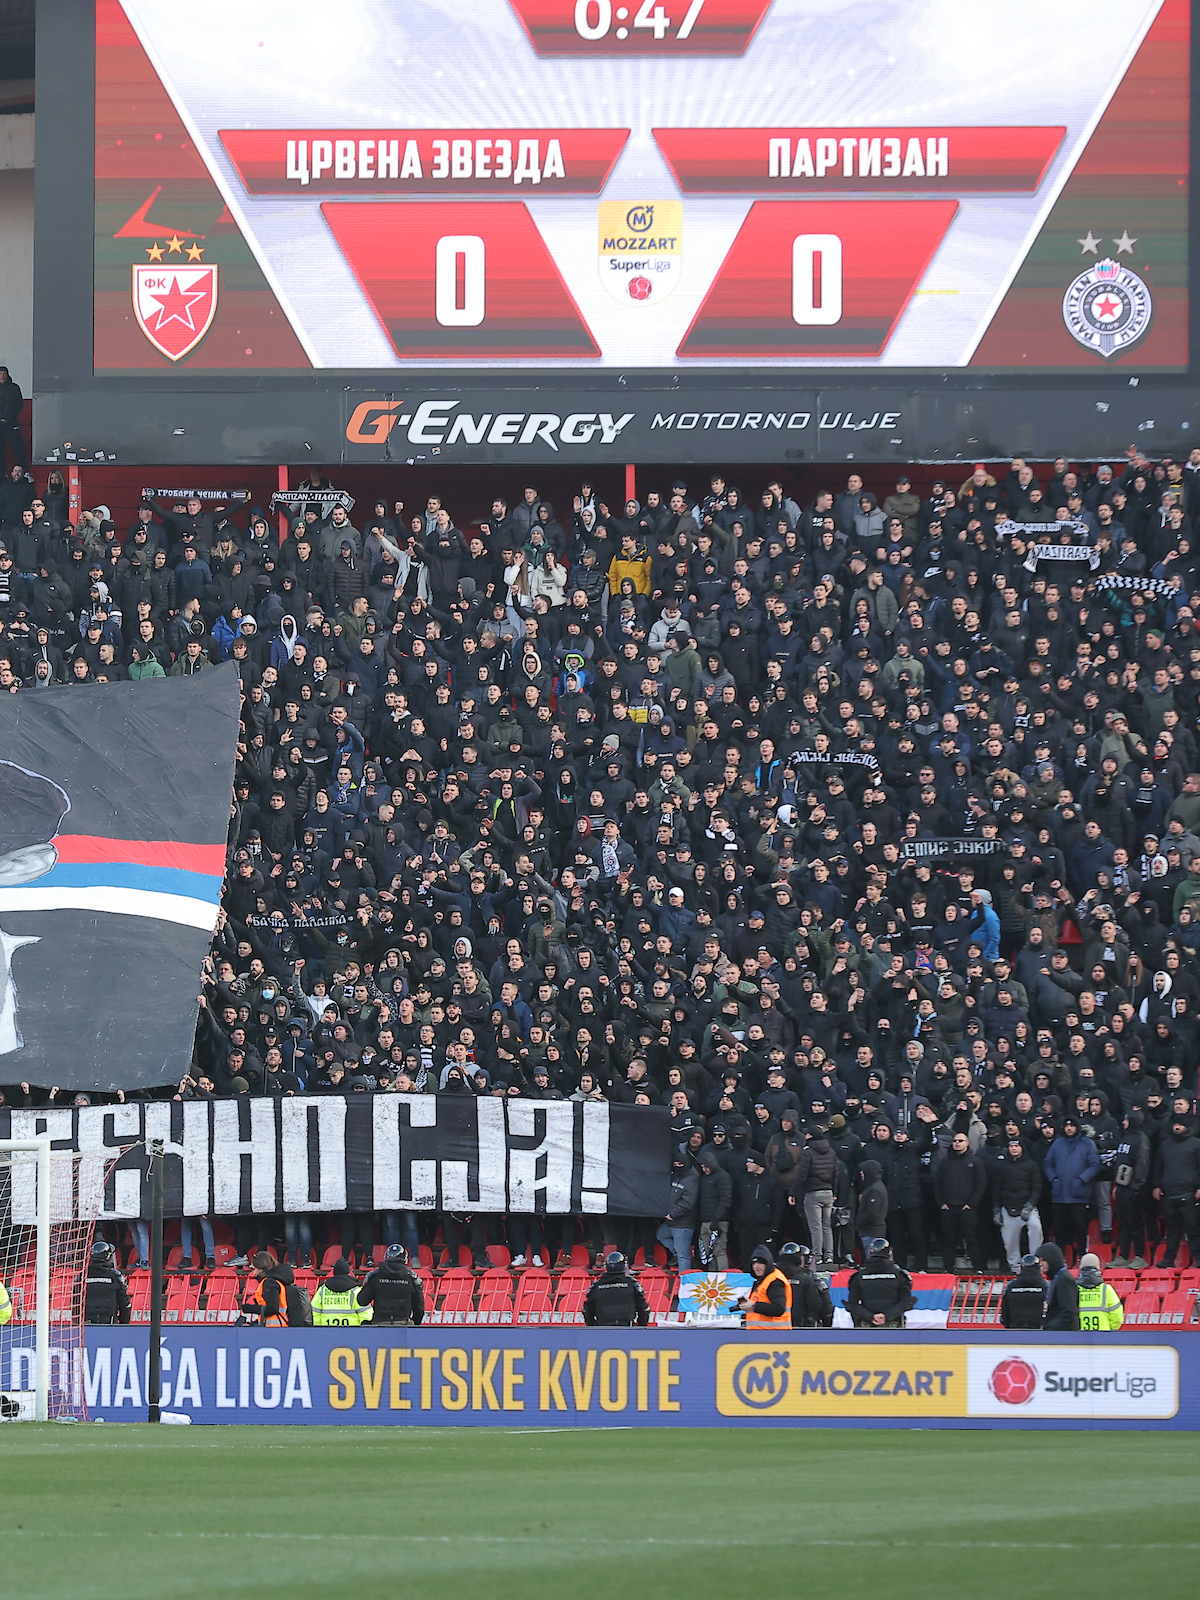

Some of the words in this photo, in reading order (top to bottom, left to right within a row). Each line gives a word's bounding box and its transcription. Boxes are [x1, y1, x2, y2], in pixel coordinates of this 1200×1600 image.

[574, 0, 699, 41] 0:47
[285, 139, 426, 185] ЦРВЕНА
[432, 138, 567, 182] ЗВЕЗДА
[767, 138, 949, 179] ПАРТИЗАН
[603, 237, 677, 251] MOZZART
[609, 258, 671, 273] SuperLiga
[144, 277, 167, 289] ФК
[434, 234, 486, 327] 0
[792, 233, 843, 326] 0
[650, 412, 811, 430] MOTORNO
[818, 412, 901, 431] ULJE
[275, 492, 307, 501] PARTIZAN
[323, 1296, 350, 1306] SECURITY
[215, 1346, 313, 1409] LIGA
[327, 1347, 525, 1411] SVETSKE
[538, 1348, 681, 1412] KVOTE
[801, 1370, 954, 1396] MOZZART
[1044, 1370, 1157, 1398] SuperLiga
